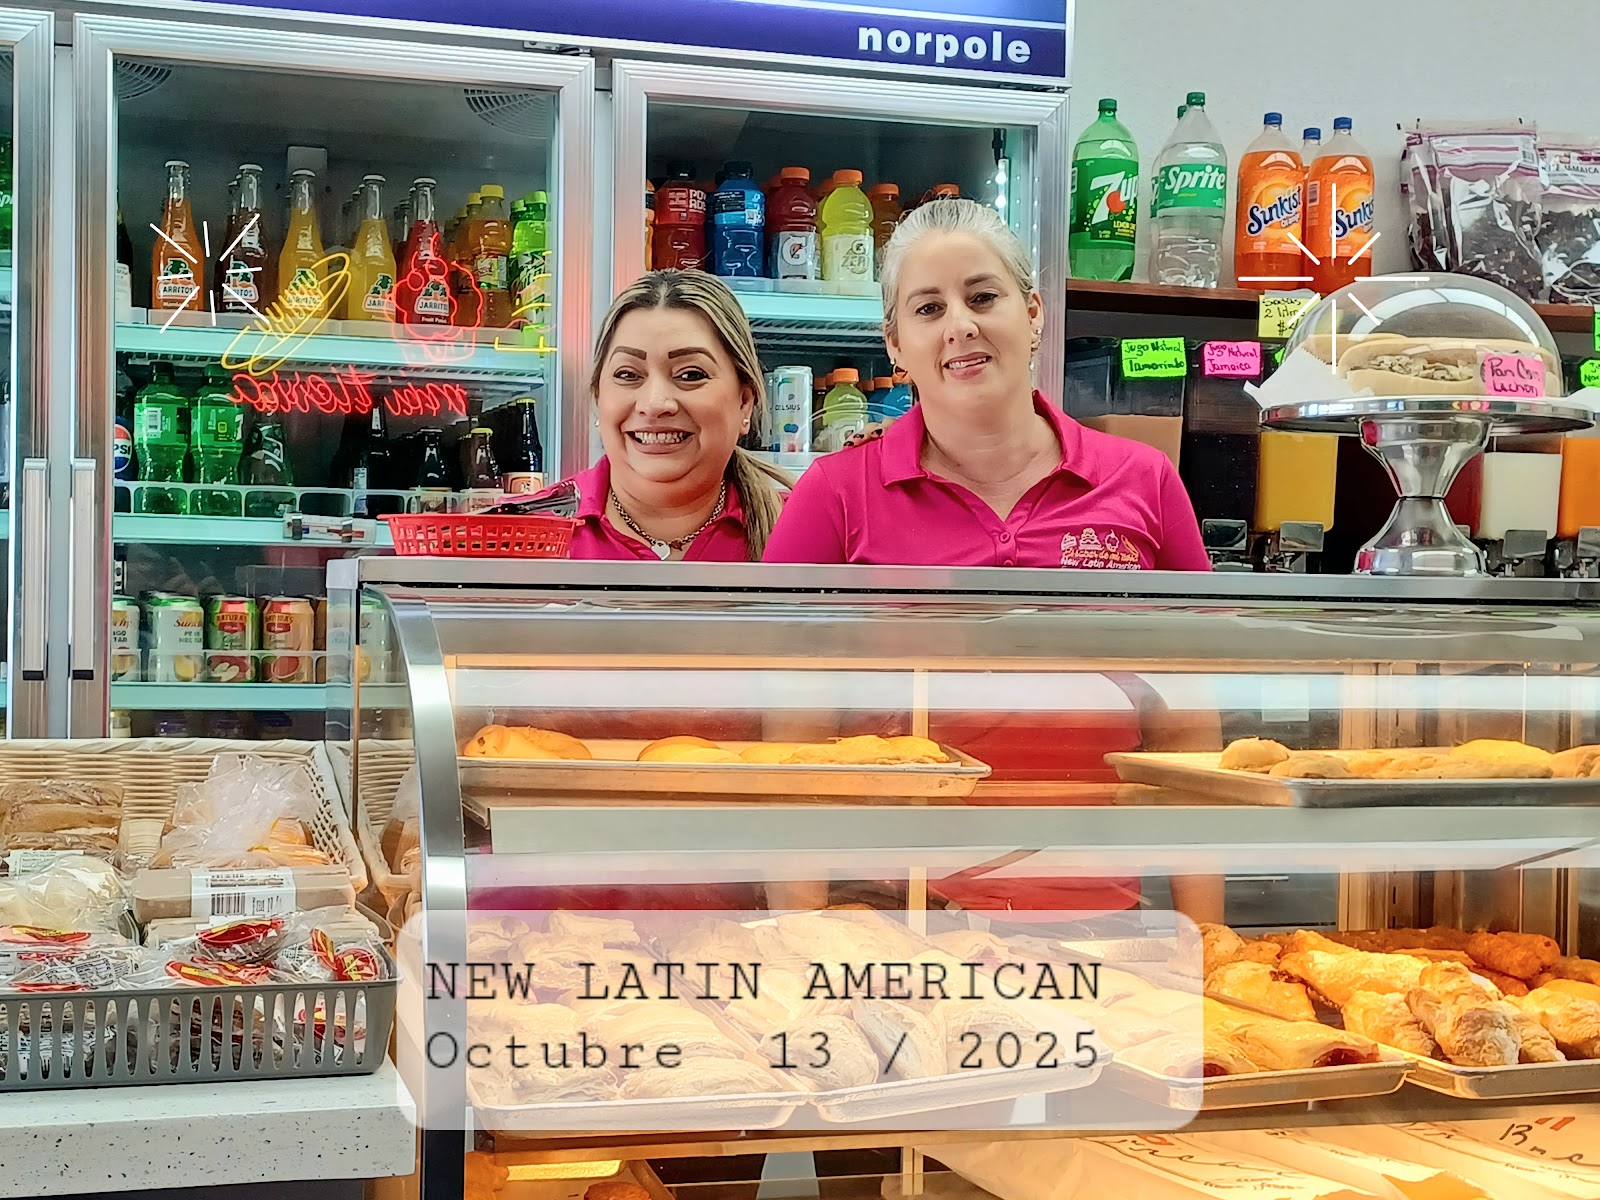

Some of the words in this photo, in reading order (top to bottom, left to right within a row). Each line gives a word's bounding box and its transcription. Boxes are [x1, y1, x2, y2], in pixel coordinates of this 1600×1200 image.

[858, 27, 1031, 64] norpole
[1165, 165, 1225, 194] Sprite
[1247, 185, 1302, 235] Sunkist
[1264, 308, 1274, 318] 2
[1125, 341, 1149, 356] Jugo
